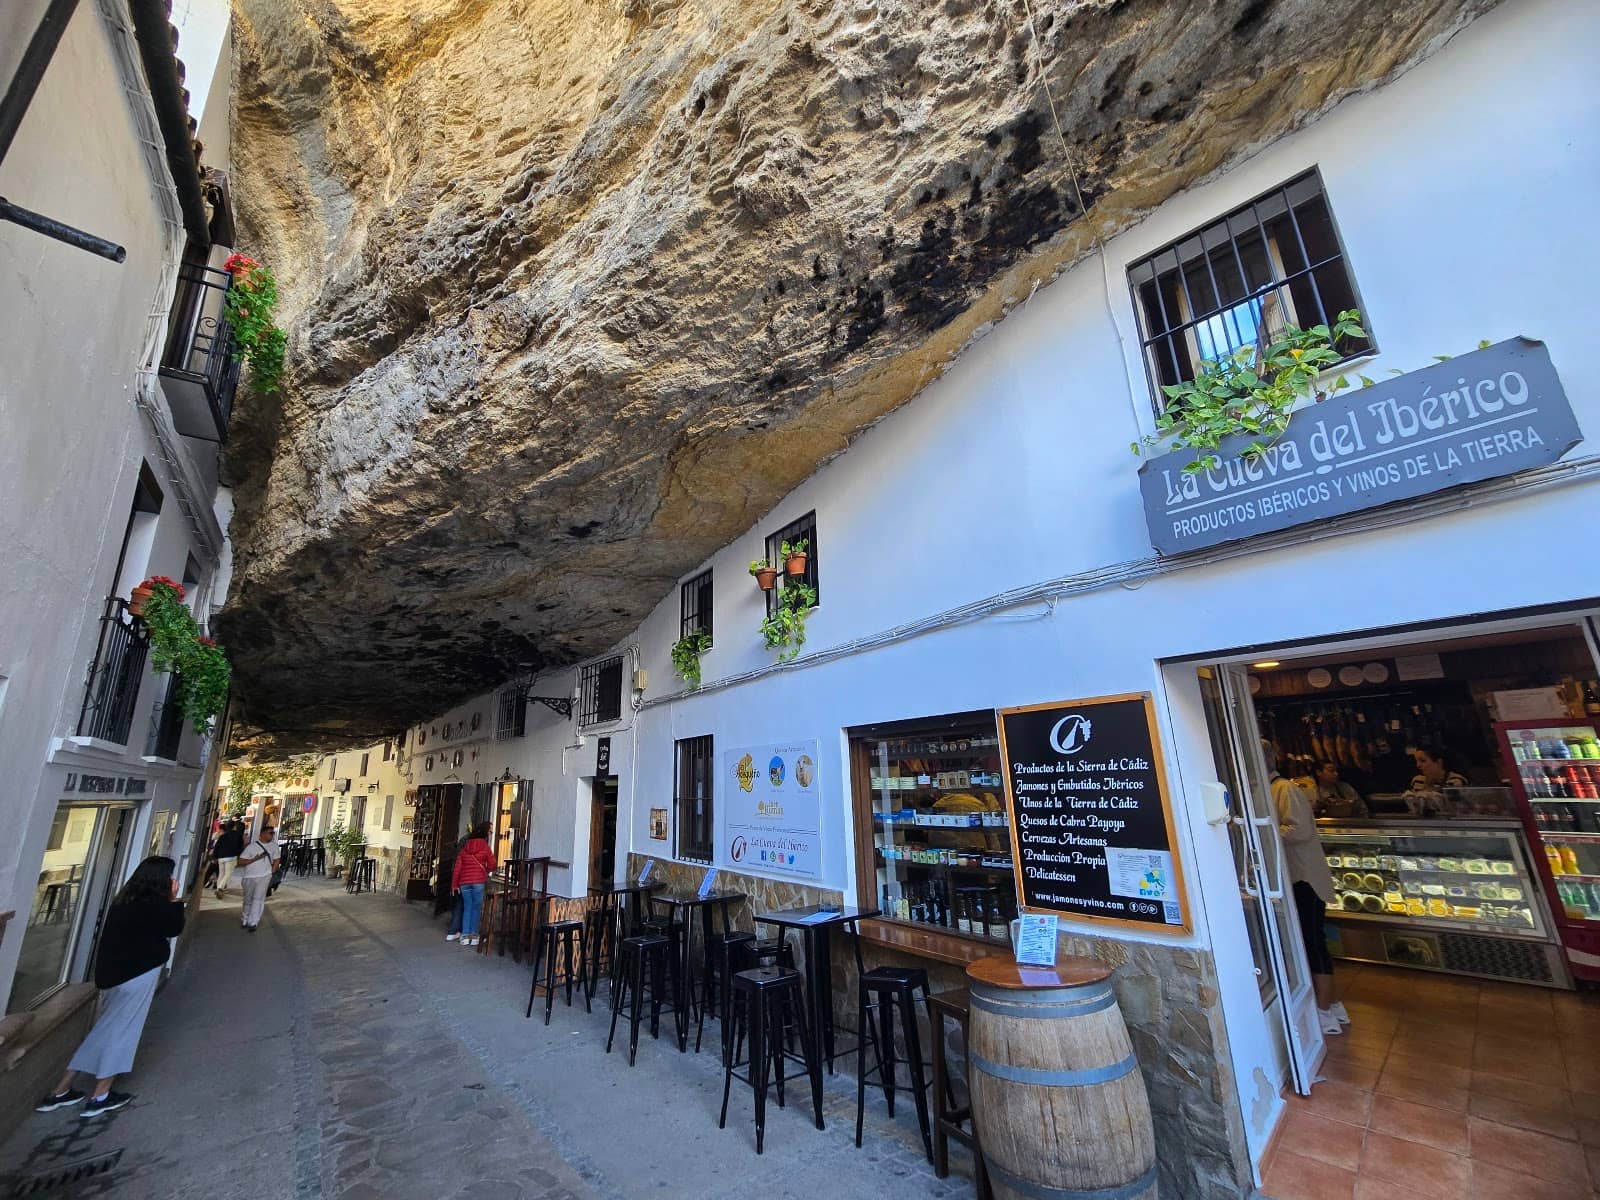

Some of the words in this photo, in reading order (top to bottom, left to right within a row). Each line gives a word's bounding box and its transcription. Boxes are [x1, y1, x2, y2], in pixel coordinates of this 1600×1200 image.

[1162, 470, 1200, 506] La
[1206, 440, 1303, 492] Cueva
[1309, 411, 1366, 462] del
[1367, 371, 1529, 445] Ibérico
[1173, 502, 1256, 539] PRODUCTOS
[1258, 481, 1330, 517] IBÉRICOS
[1331, 476, 1344, 497] Y
[1345, 465, 1401, 493] VINOS
[1403, 454, 1432, 480] DE
[1432, 447, 1462, 472] LA
[1462, 425, 1545, 464] TIERRA
[1013, 762, 1055, 774] Productos
[1056, 761, 1065, 773] de
[1067, 760, 1075, 772] la
[1076, 759, 1106, 772] Sierra
[1108, 758, 1119, 771] de
[1120, 757, 1149, 771] Cádiz
[1015, 779, 1049, 794] Jamones
[1050, 783, 1056, 795] y
[1057, 777, 1101, 791] Embutidos
[1043, 796, 1053, 808] de
[1054, 796, 1063, 808] la
[1066, 796, 1097, 809] Tierra
[1098, 796, 1109, 809] de
[1110, 796, 1139, 809] Cádiz
[1020, 813, 1048, 829] Quesos
[1049, 814, 1059, 826] de
[1060, 814, 1086, 827] Cabra
[1086, 814, 1125, 833] Payoya
[1022, 831, 1056, 844] Cervezas
[1058, 832, 1108, 847] Artesanas
[1023, 849, 1070, 863] Producción
[1071, 851, 1106, 869] Propia
[1025, 866, 1076, 882] Delicatessen
